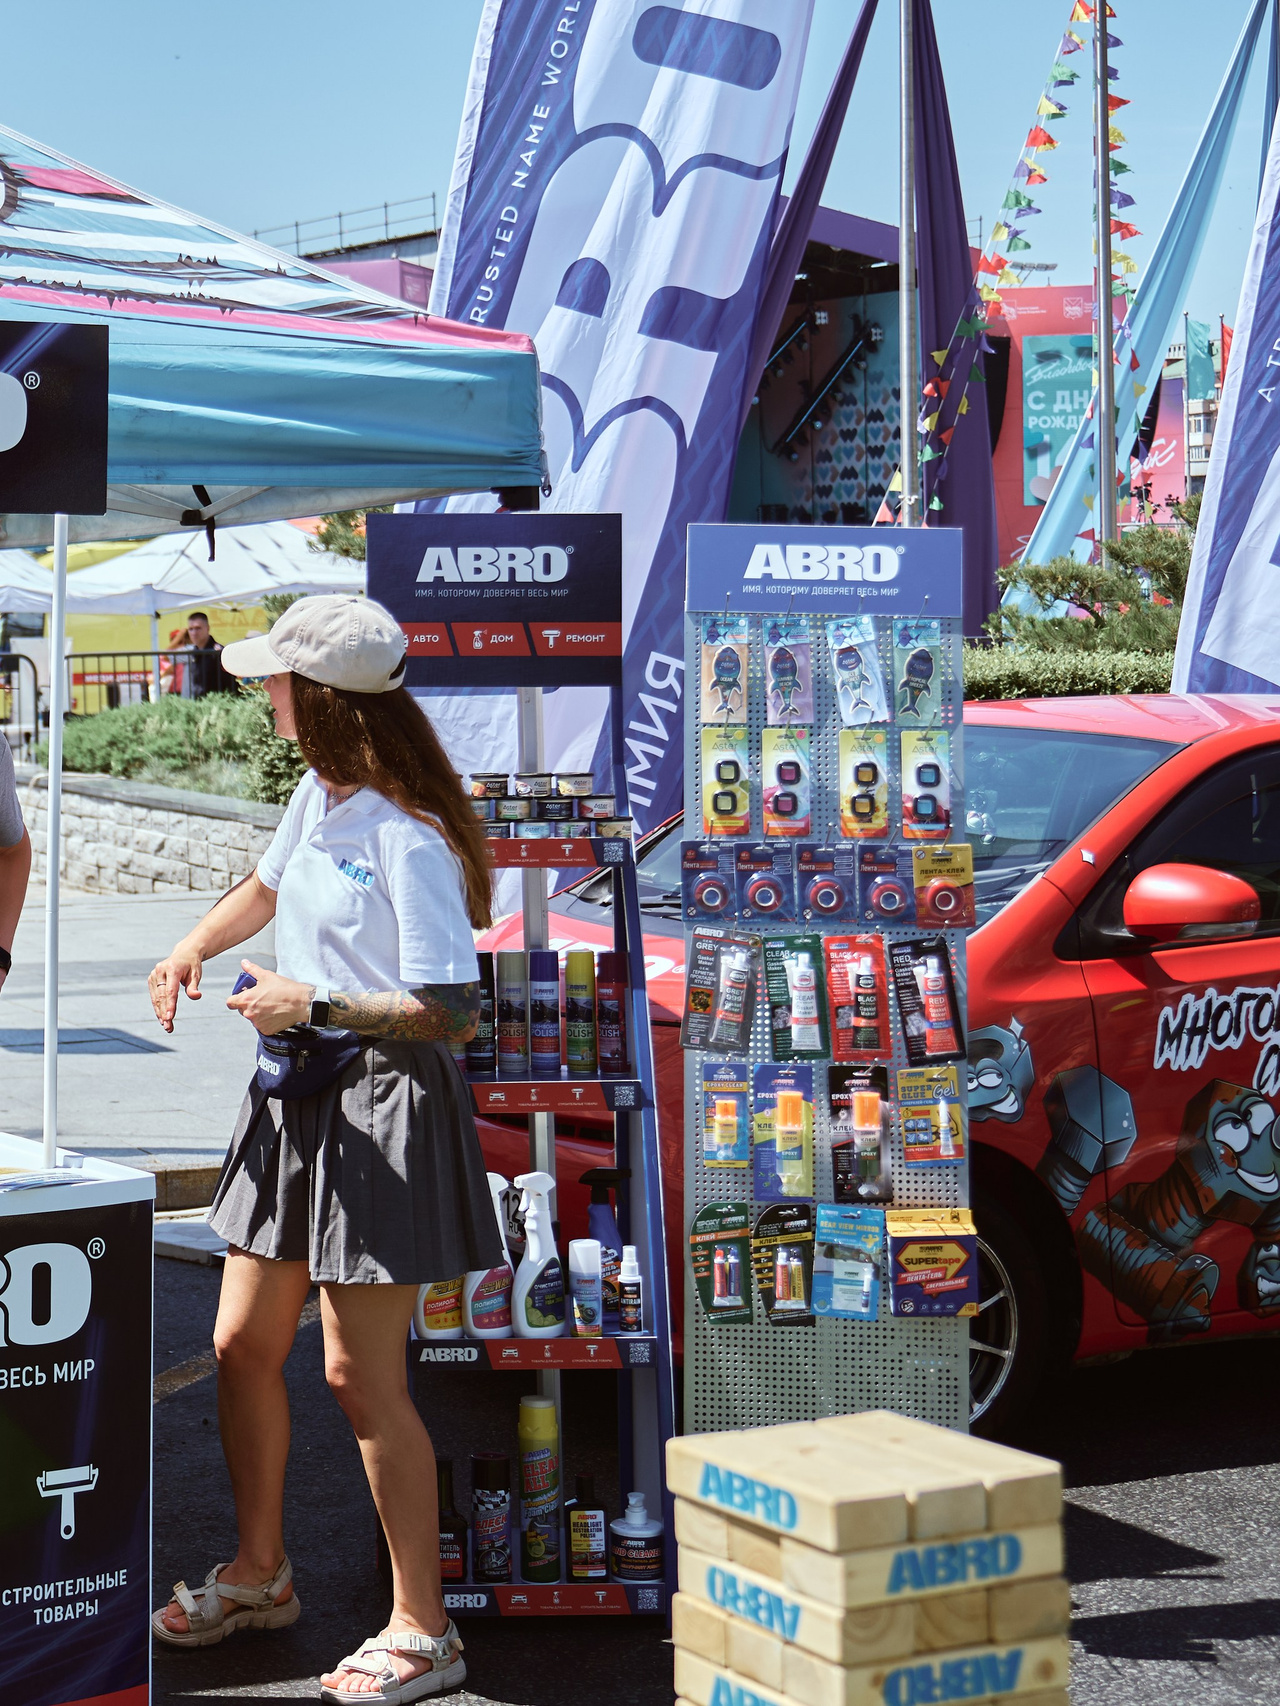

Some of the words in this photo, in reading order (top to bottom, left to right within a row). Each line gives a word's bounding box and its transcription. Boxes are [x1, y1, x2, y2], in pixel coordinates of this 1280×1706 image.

[469, 206, 518, 324] RUSTED
[512, 104, 550, 189] NAME
[542, 0, 581, 87] WORL
[1027, 391, 1046, 411] С
[1053, 390, 1089, 413] ДН
[415, 546, 569, 583] ABRO
[743, 544, 900, 581] ABRO
[415, 589, 436, 598] ИМЯ,
[438, 588, 481, 597] КОТОРОМУ
[483, 588, 525, 599] ДОВЕРЯЕТ
[527, 588, 549, 598] ВЕСЬ
[550, 588, 569, 598] МИР
[742, 585, 763, 595] ИМЯ,
[766, 585, 809, 595] КОТОРОМУ
[811, 586, 854, 596] ДОВЕРЯЕТ
[857, 587, 878, 597] ВЕСЬ
[880, 588, 899, 597] МИР
[412, 634, 439, 643] АВТО
[490, 634, 514, 644] ДОМ
[566, 634, 605, 643] РЕМОНТ
[337, 858, 375, 888] ABRO
[694, 927, 724, 938] ABRO
[695, 942, 719, 952] GREY
[766, 950, 790, 958] CLEAR
[893, 955, 911, 964] RED
[928, 996, 944, 1004] RED
[1154, 982, 1280, 1071] МНОГО
[476, 1029, 492, 1037] LISH
[498, 1029, 526, 1037] POLISH
[532, 1029, 558, 1037] POLISH
[567, 1029, 593, 1037] OLISH
[258, 1054, 280, 1075] ABRO
[901, 1084, 932, 1093] SUPER
[932, 1080, 955, 1098] Gel
[901, 1092, 926, 1100] GLUE
[502, 1191, 522, 1223] 12
[838, 1222, 854, 1230] VIEW
[855, 1224, 880, 1233] MIRROR
[696, 1233, 715, 1242] КЛЕЙ
[759, 1236, 778, 1244] КЛЕЙ
[904, 1257, 961, 1265] SUPERtape
[906, 1272, 942, 1282] ЛЕНТА-ГЕЛЬ
[426, 1299, 455, 1310] ПОЛИРОЛЬ
[473, 1297, 503, 1309] ПОЛИРОЛЬ
[419, 1347, 478, 1362] ABRO
[53, 1359, 95, 1384] МИР
[524, 1474, 550, 1493] ALL
[698, 1461, 799, 1531] ABRO
[524, 1507, 543, 1519] Foam
[475, 1514, 508, 1529] БЛЕСК
[440, 1544, 460, 1552] ТИТЕЛЬ
[886, 1533, 1024, 1595] ABRO
[2, 1569, 128, 1606] СТРОИТЕЛЬНЫЕ
[441, 1593, 487, 1609] BRO
[705, 1565, 803, 1644] ABRO
[34, 1599, 99, 1626] ТОВАРЫ
[883, 1647, 1025, 1706] ABRO
